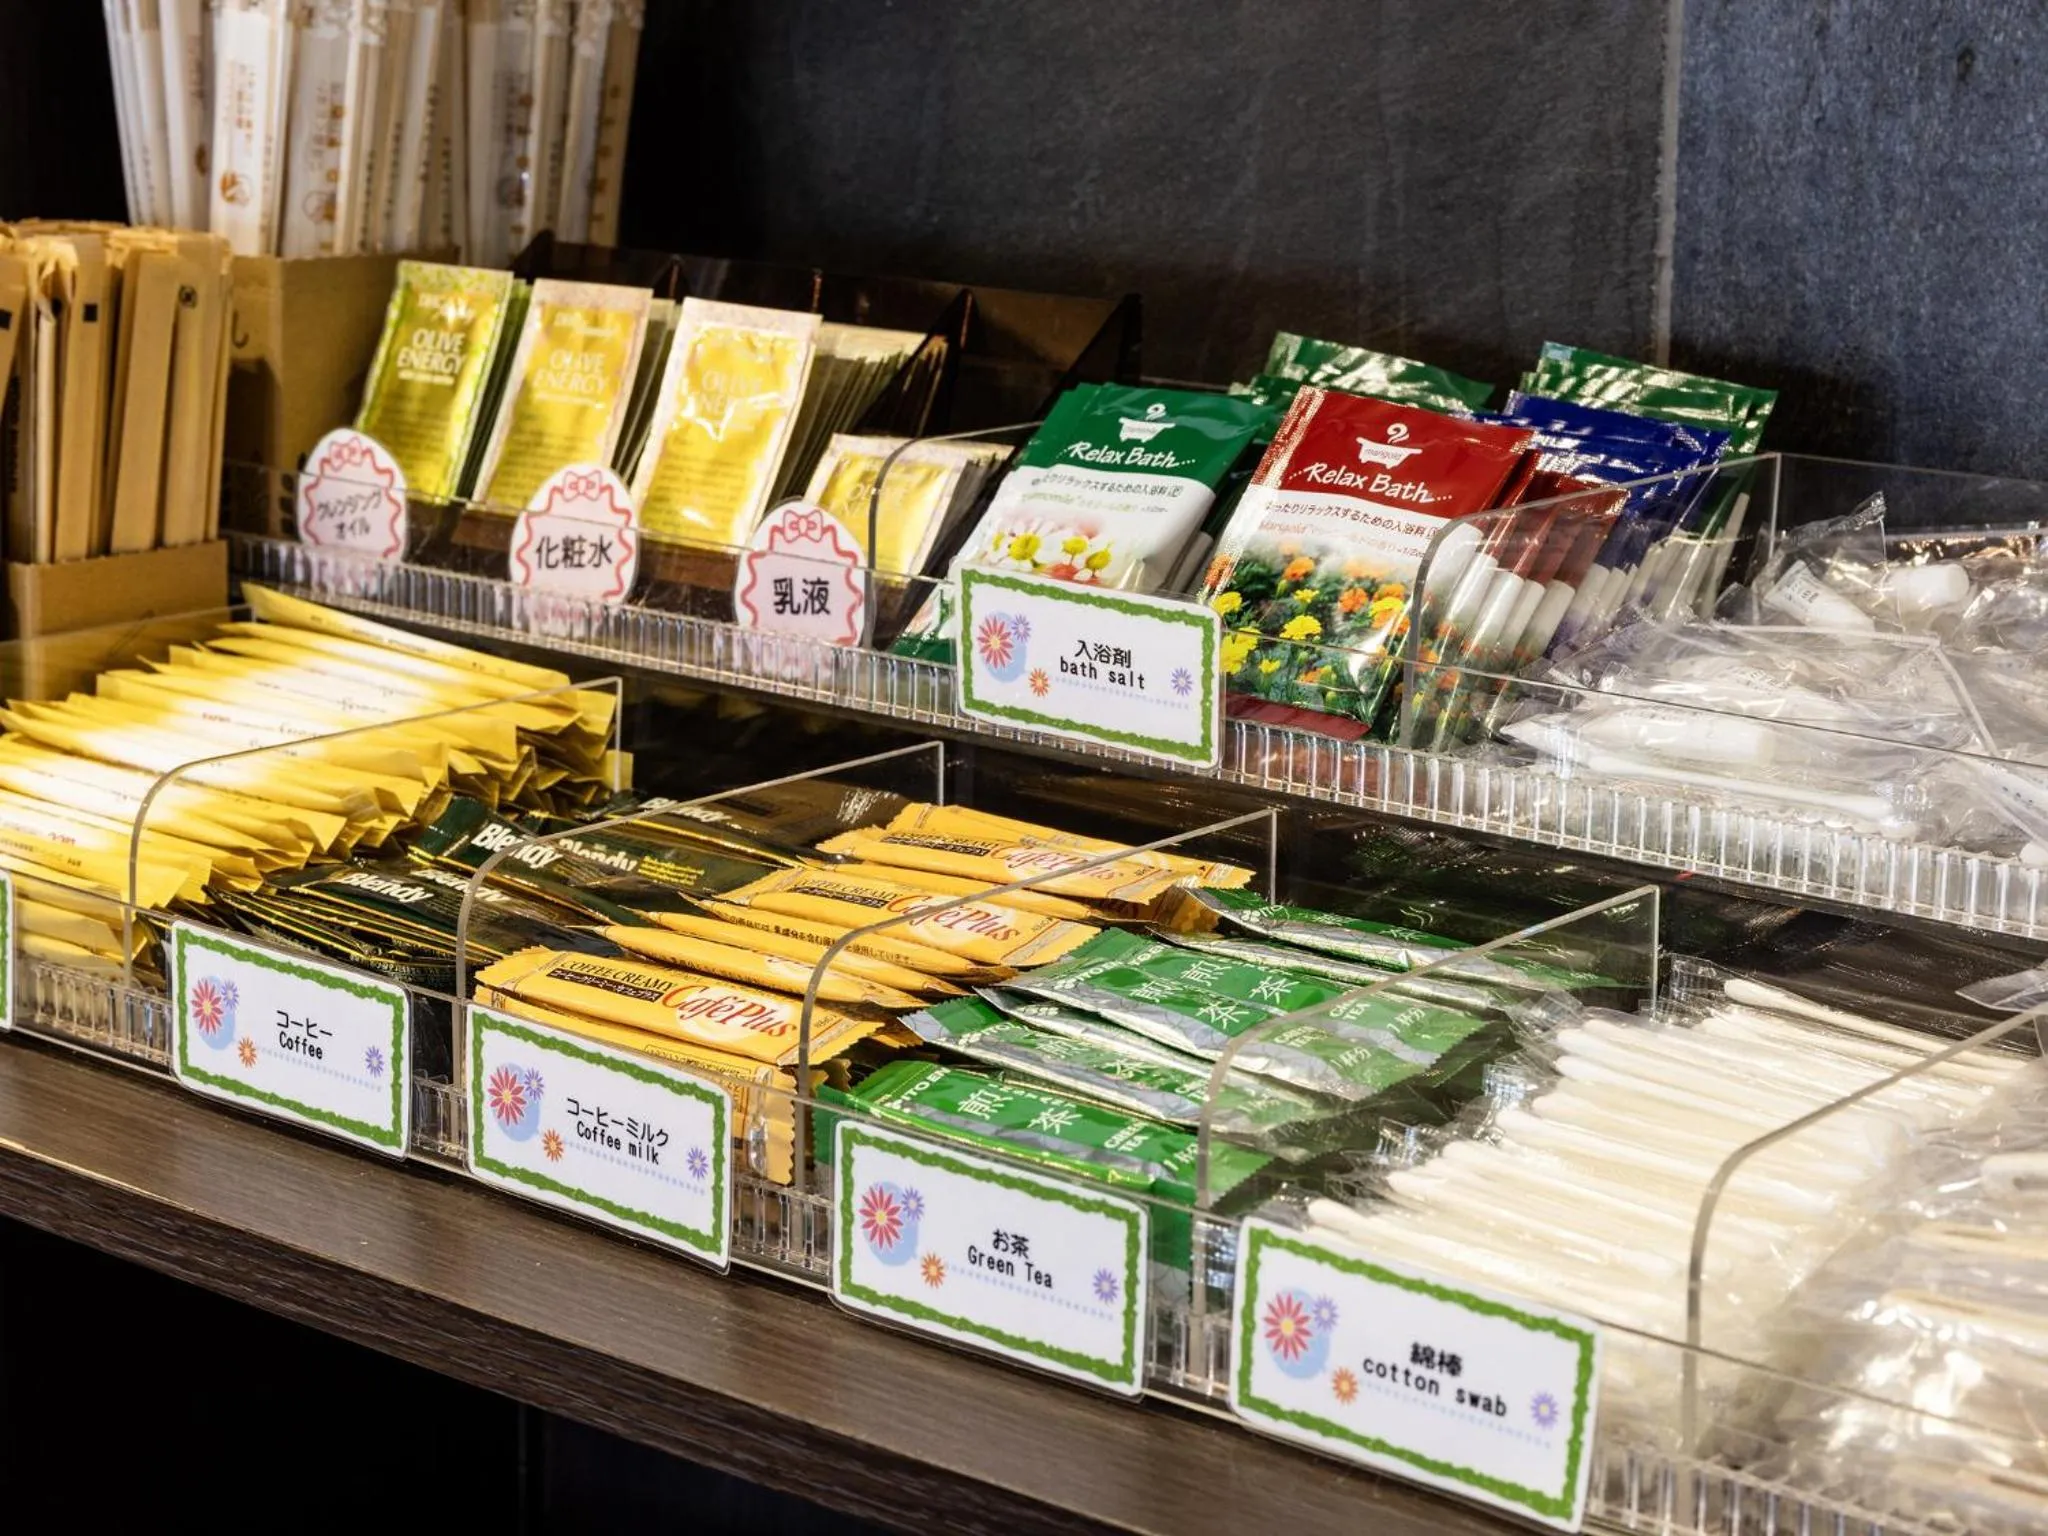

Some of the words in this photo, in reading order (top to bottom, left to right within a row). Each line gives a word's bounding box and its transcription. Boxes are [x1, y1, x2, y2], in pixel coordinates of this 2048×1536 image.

[413, 327, 466, 353] OLIVE
[397, 346, 467, 375] ENERGY
[1067, 440, 1126, 465] Relax
[1303, 461, 1369, 489] Relax
[535, 533, 613, 570] 化粧水
[773, 576, 832, 616] 乳液
[1074, 639, 1132, 669] 入浴剤
[1059, 655, 1098, 680] bath
[1108, 670, 1146, 690] salt
[339, 872, 435, 902] Blendy
[560, 959, 613, 978] COFFEE
[611, 968, 677, 992] CREAMY
[276, 1009, 334, 1039] コーヒー
[279, 1031, 323, 1060] Coffee
[566, 1097, 669, 1147] コーヒーミルク
[576, 1120, 622, 1151] Coffee
[628, 1141, 660, 1165] milk
[992, 1228, 1030, 1260] お茶
[967, 1244, 1015, 1278] Green
[1024, 1261, 1054, 1289] Tea
[1410, 1341, 1464, 1377] 綿棒
[1362, 1357, 1441, 1396] cotton
[1455, 1387, 1508, 1417] swab
